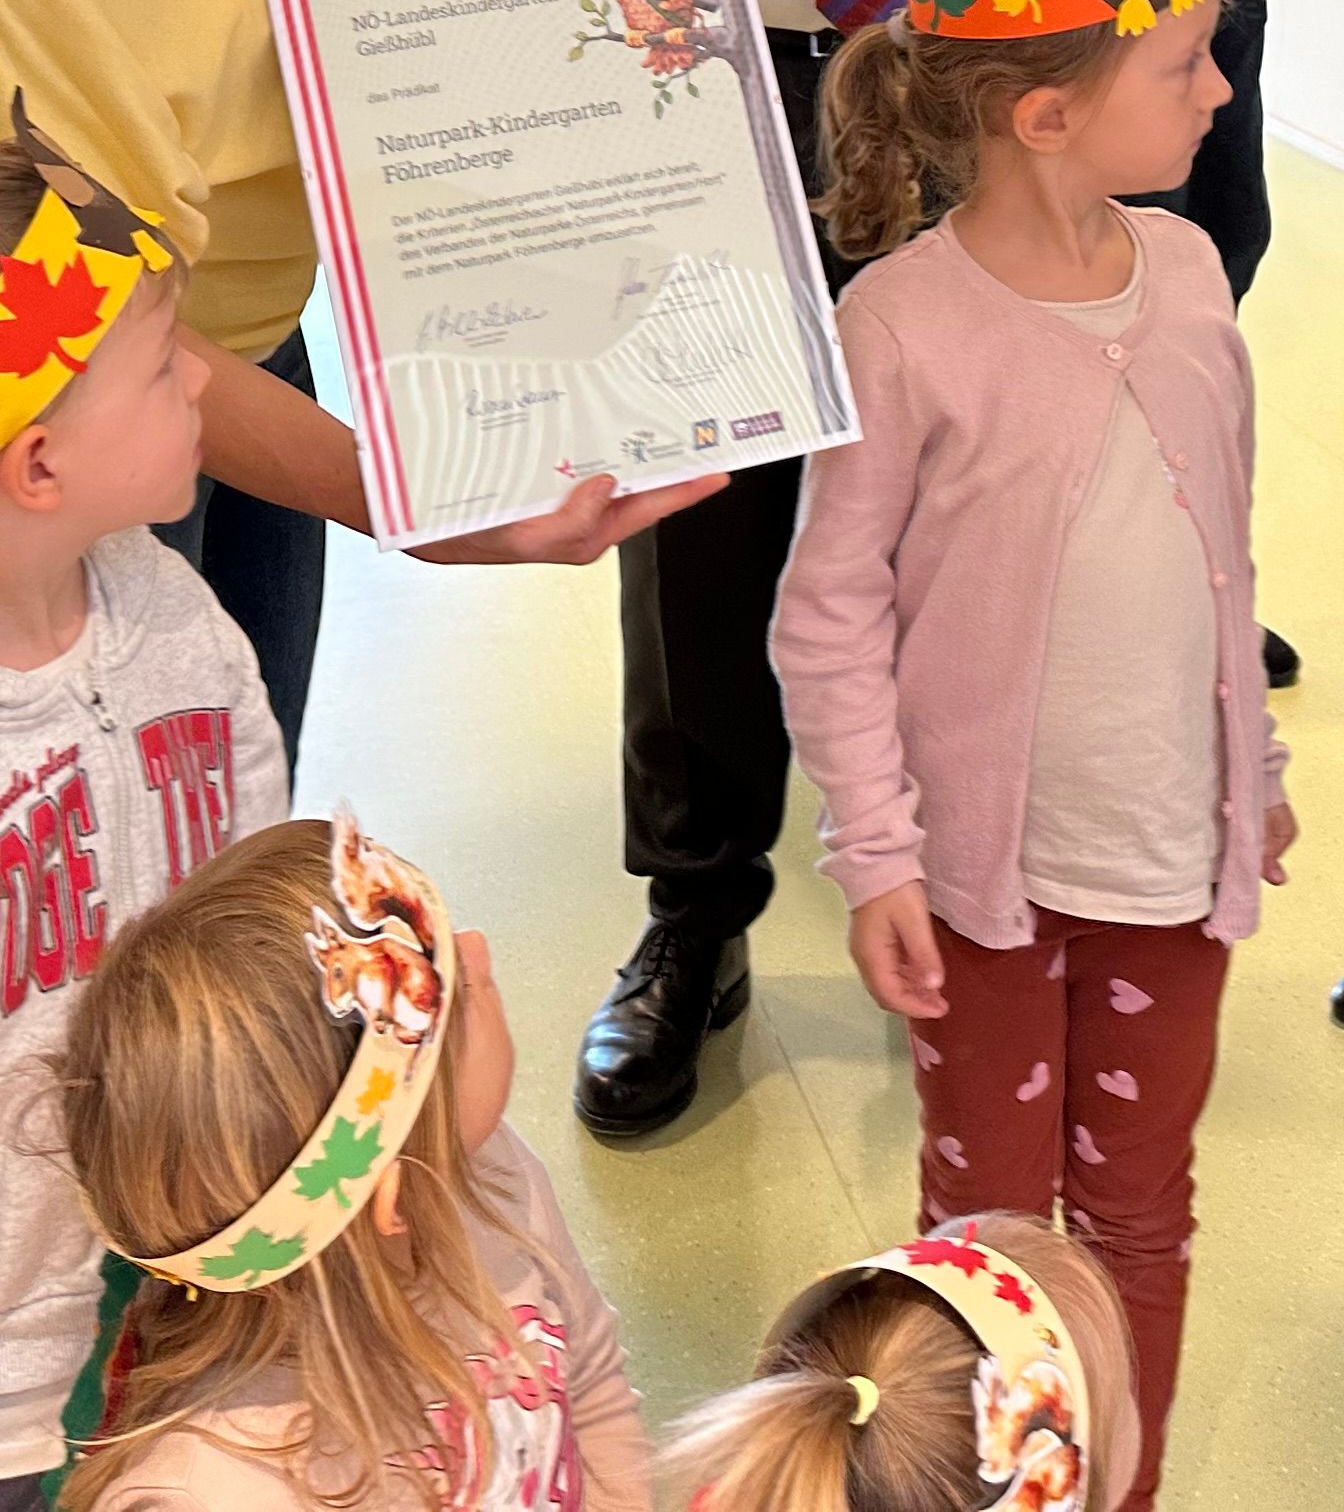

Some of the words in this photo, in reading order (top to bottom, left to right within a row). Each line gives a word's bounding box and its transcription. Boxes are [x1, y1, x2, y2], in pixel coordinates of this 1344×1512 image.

[356, 30, 437, 56] Gießhübl
[376, 99, 623, 155] Naturpark-Kindergarten
[382, 147, 514, 185] Föhrenberge
